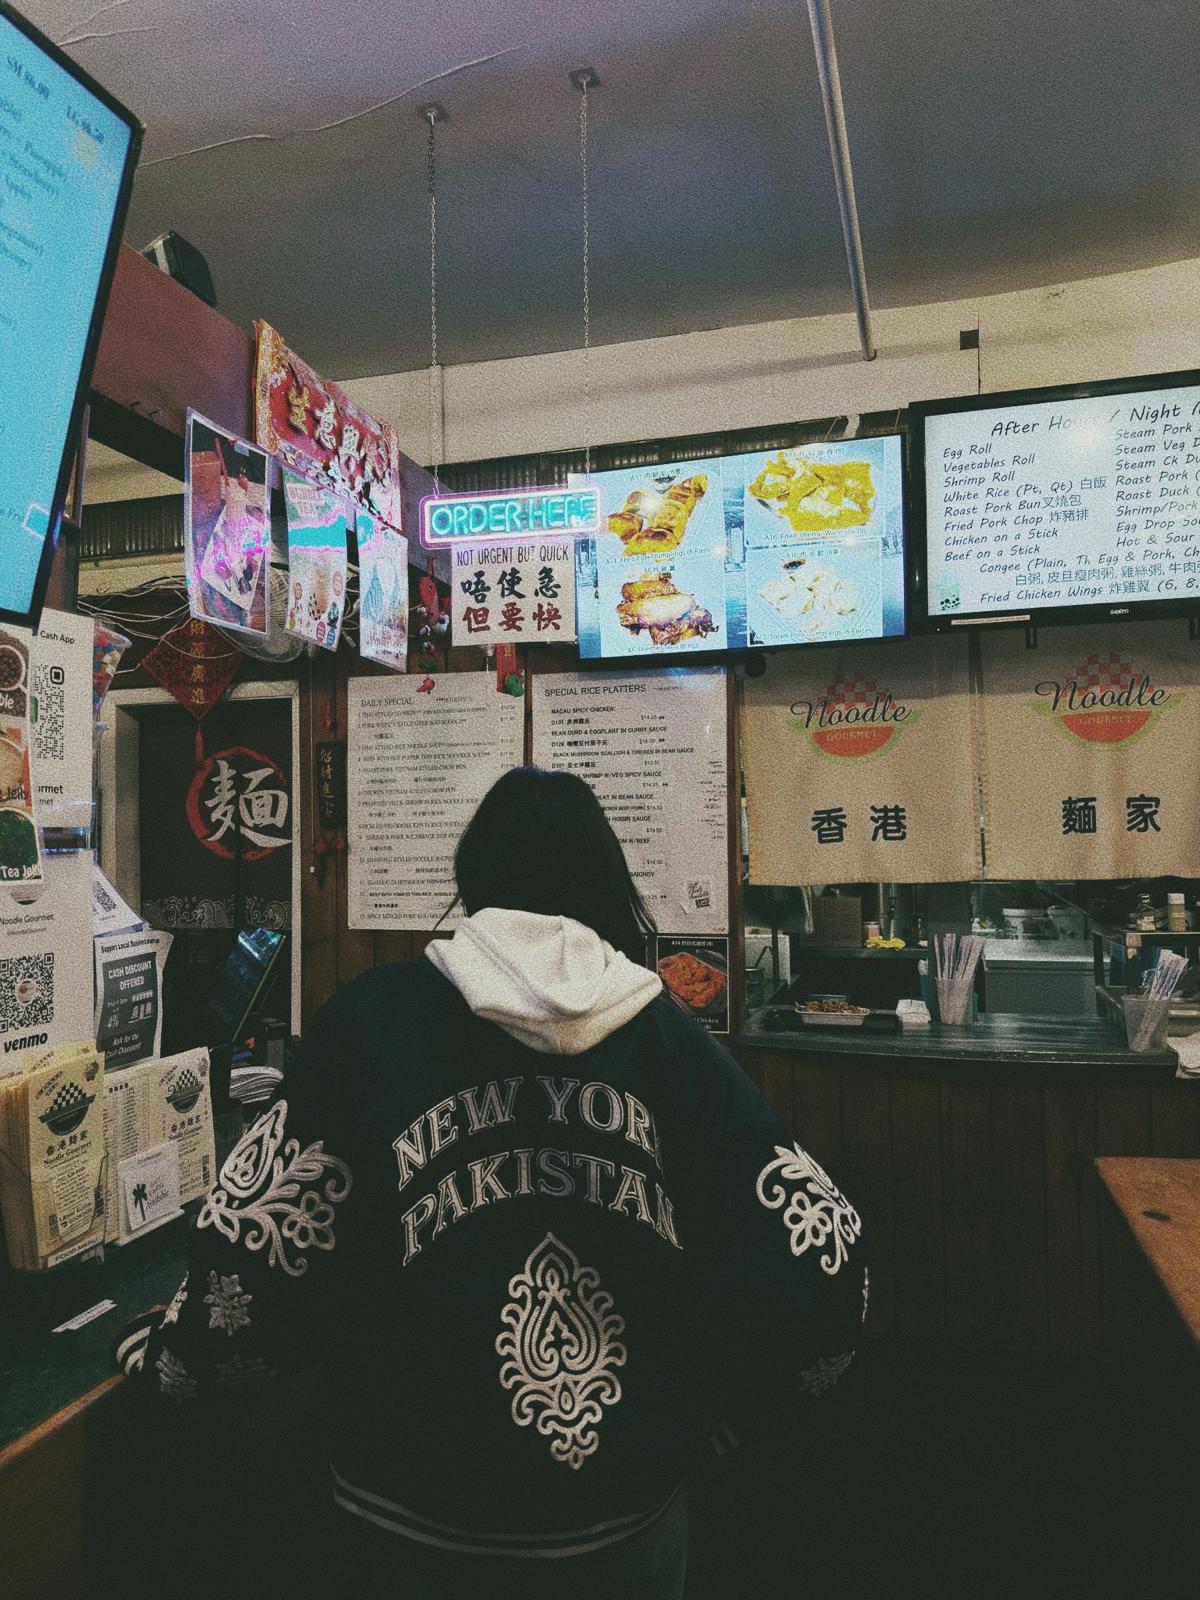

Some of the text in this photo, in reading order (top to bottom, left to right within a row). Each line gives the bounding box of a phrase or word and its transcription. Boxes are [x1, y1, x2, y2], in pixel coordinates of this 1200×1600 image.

[991, 420, 1040, 437] After
[1129, 403, 1182, 424] Night
[1115, 422, 1192, 440] Steam Pork
[943, 443, 993, 460] Egg Roll
[1115, 440, 1185, 456] Steam Veg
[944, 453, 1036, 474] Vegetables Roll
[1115, 454, 1178, 472] Steam Ck
[944, 471, 1016, 488] Shrimp Roll
[1115, 469, 1188, 486] Roast Pork
[944, 490, 979, 503] White
[986, 487, 1010, 499] Rice
[1050, 481, 1073, 494] Qt)
[1115, 485, 1190, 502] Roast Duck
[431, 494, 597, 536] ORDER HERE
[944, 504, 978, 517] Roast
[985, 501, 1012, 514] Pork
[1018, 499, 1041, 511] Bun
[1116, 500, 1199, 517] Shrimp/Pork
[944, 520, 973, 532] Fried
[980, 517, 1007, 530] Pork
[1013, 515, 1043, 527] Chop
[1116, 519, 1175, 534] Egg Drop
[944, 527, 1058, 547] Chicken on a Stick
[1117, 530, 1195, 548] Hot & Sour
[457, 544, 569, 567] NOT URGENT BUT QUICK
[944, 544, 1040, 562] Beef on a Stick
[979, 562, 1021, 574] Congee
[1098, 552, 1119, 565] Egg
[1124, 551, 1136, 562] &
[460, 566, 562, 604] 唔使急
[980, 591, 1010, 603] Fried
[1016, 588, 1061, 601] Chicken
[1068, 585, 1103, 598] Wings
[462, 602, 563, 634] 但要快
[40, 630, 75, 645] Cash App
[545, 684, 646, 697] SPECIAL RICE PLATTERS
[1034, 677, 1172, 713] Noodle
[361, 697, 414, 708] DAILY SPECIAL
[790, 694, 914, 730] Noodle
[1061, 794, 1162, 836] 麵家
[811, 804, 908, 845] 香港
[1, 866, 20, 879] Tea
[24, 913, 54, 925] Gourmet
[101, 943, 118, 954] Support
[118, 942, 130, 951] Local
[108, 960, 152, 979] CASH DISCOUNT
[120, 975, 145, 991] OFFERED
[4, 1032, 48, 1053] venmo
[392, 1075, 663, 1193] NEW YOR
[43, 1141, 92, 1166] Noodle Gourmet
[55, 1237, 99, 1262] FOOD MENU
